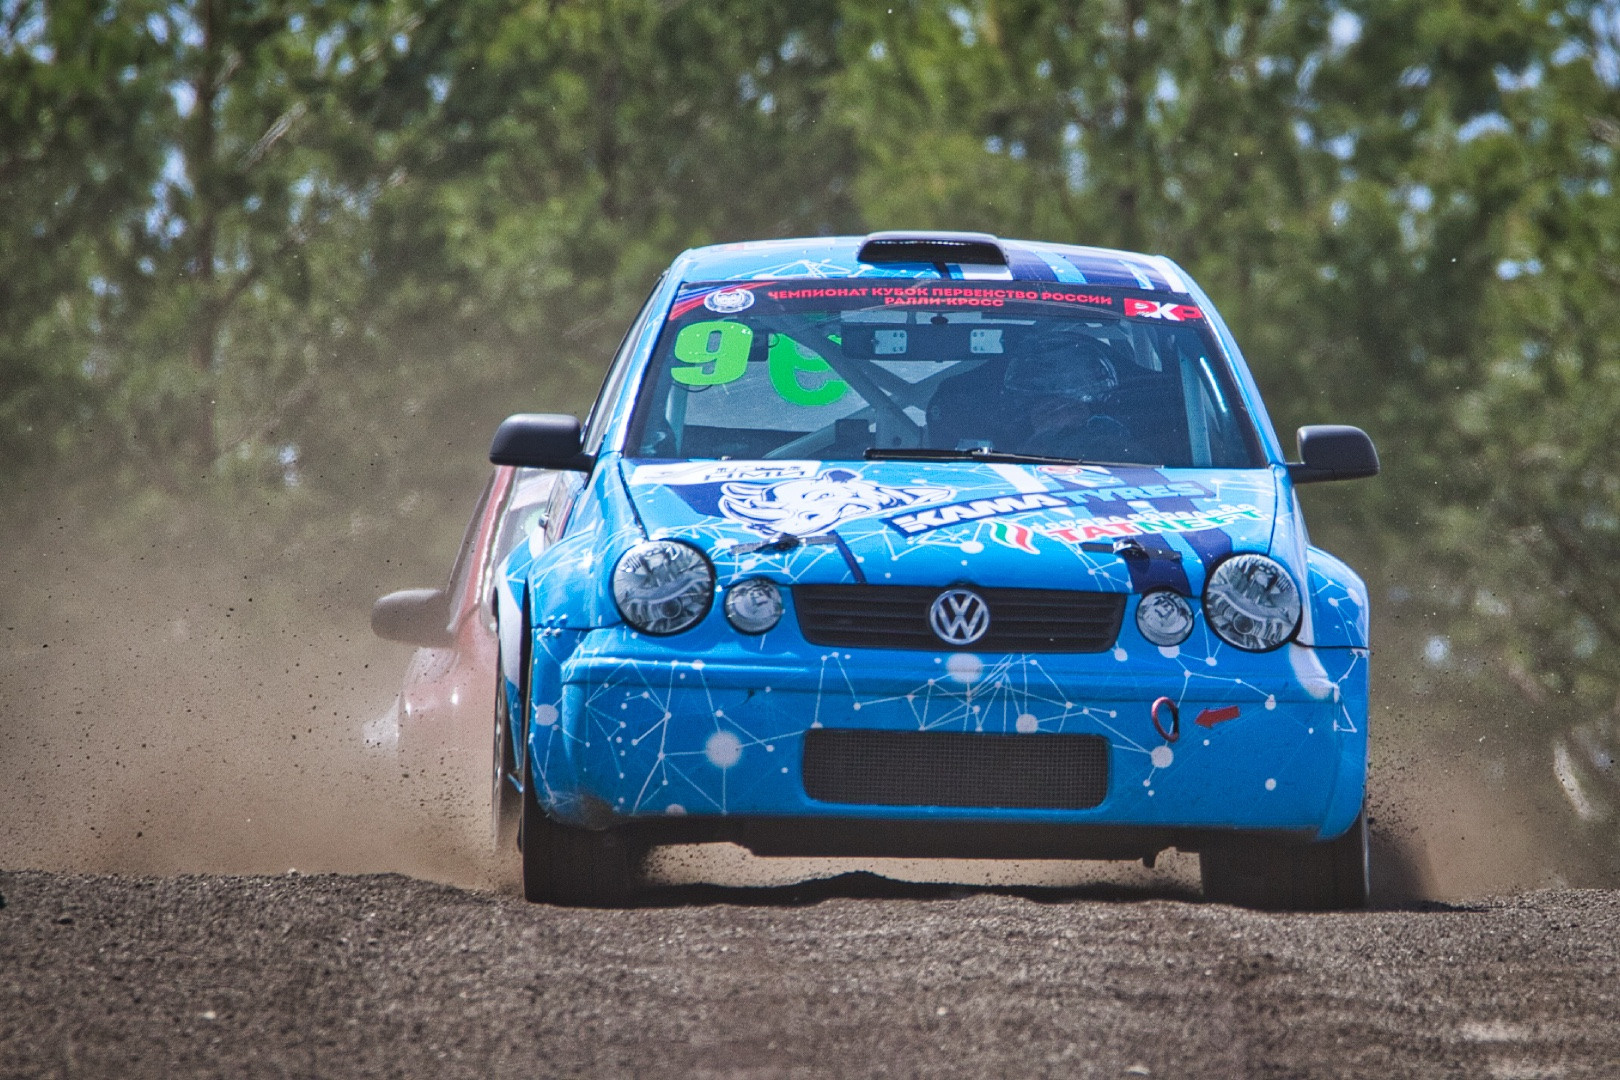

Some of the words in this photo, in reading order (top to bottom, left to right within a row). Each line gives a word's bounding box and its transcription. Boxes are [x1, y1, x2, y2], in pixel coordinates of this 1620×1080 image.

[767, 286, 868, 300] ЧЕМПИОНАТ
[872, 287, 929, 297] КУБОК
[932, 287, 1037, 300] ПЕРВЕНСТВО
[1041, 291, 1113, 306] РОССИИ
[884, 296, 1004, 308] РАЛЛИ-КРОСС
[670, 320, 754, 386] 9
[891, 493, 1068, 534] KAMA
[1052, 482, 1206, 504] TYRES
[1046, 509, 1266, 543] TATNEFT
